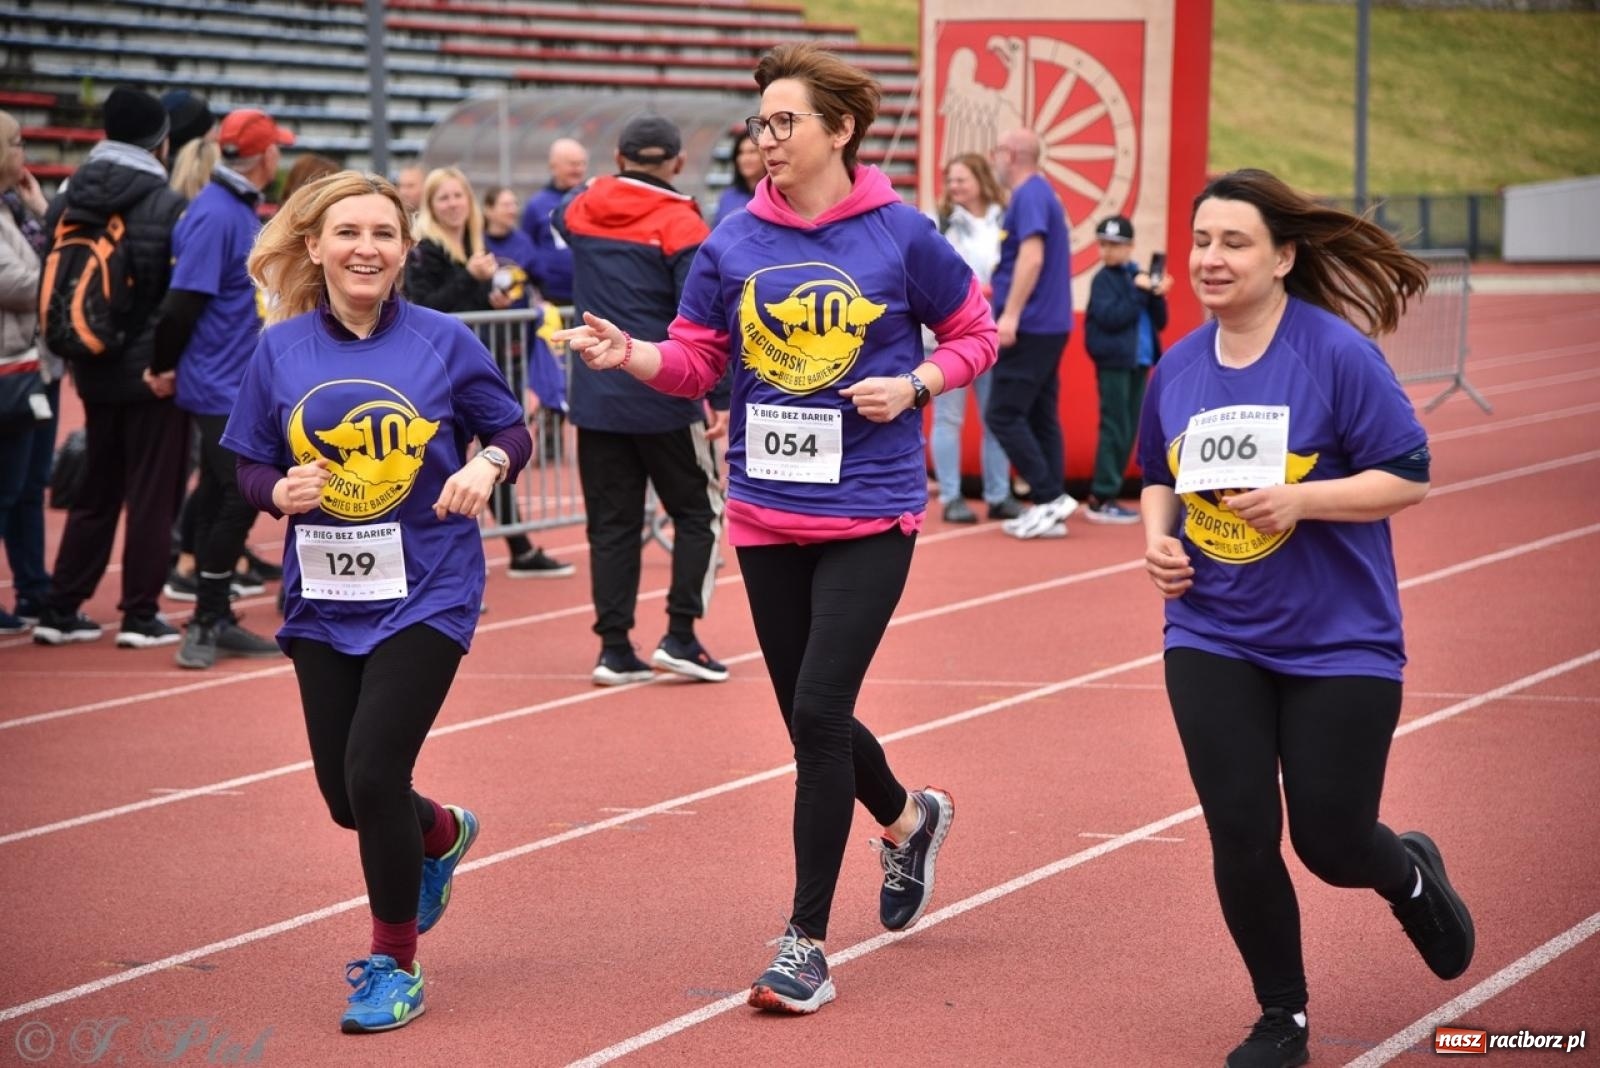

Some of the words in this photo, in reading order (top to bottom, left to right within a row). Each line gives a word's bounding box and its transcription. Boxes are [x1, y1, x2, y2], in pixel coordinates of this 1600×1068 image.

[799, 291, 848, 335] 10
[744, 322, 807, 375] RACIBORSKI
[777, 370, 793, 385] BIEG
[793, 375, 806, 387] BEZ
[807, 366, 834, 385] BARIER
[760, 409, 779, 419] BIEG
[781, 411, 799, 420] BEZ
[801, 412, 834, 423] BARIER
[1220, 411, 1237, 421] BEZ
[1240, 410, 1280, 420] BARIER
[353, 413, 407, 460] 10
[764, 430, 819, 457] 054
[1200, 434, 1258, 463] 006
[331, 496, 351, 512] BIEG
[353, 499, 368, 513] BEZ
[369, 486, 397, 510] BARIER
[304, 529, 311, 538] X
[313, 530, 333, 540] BIEG
[335, 531, 353, 540] BEZ
[356, 528, 393, 540] BARIER
[1234, 542, 1250, 555] BEZ
[325, 552, 376, 576] 129
